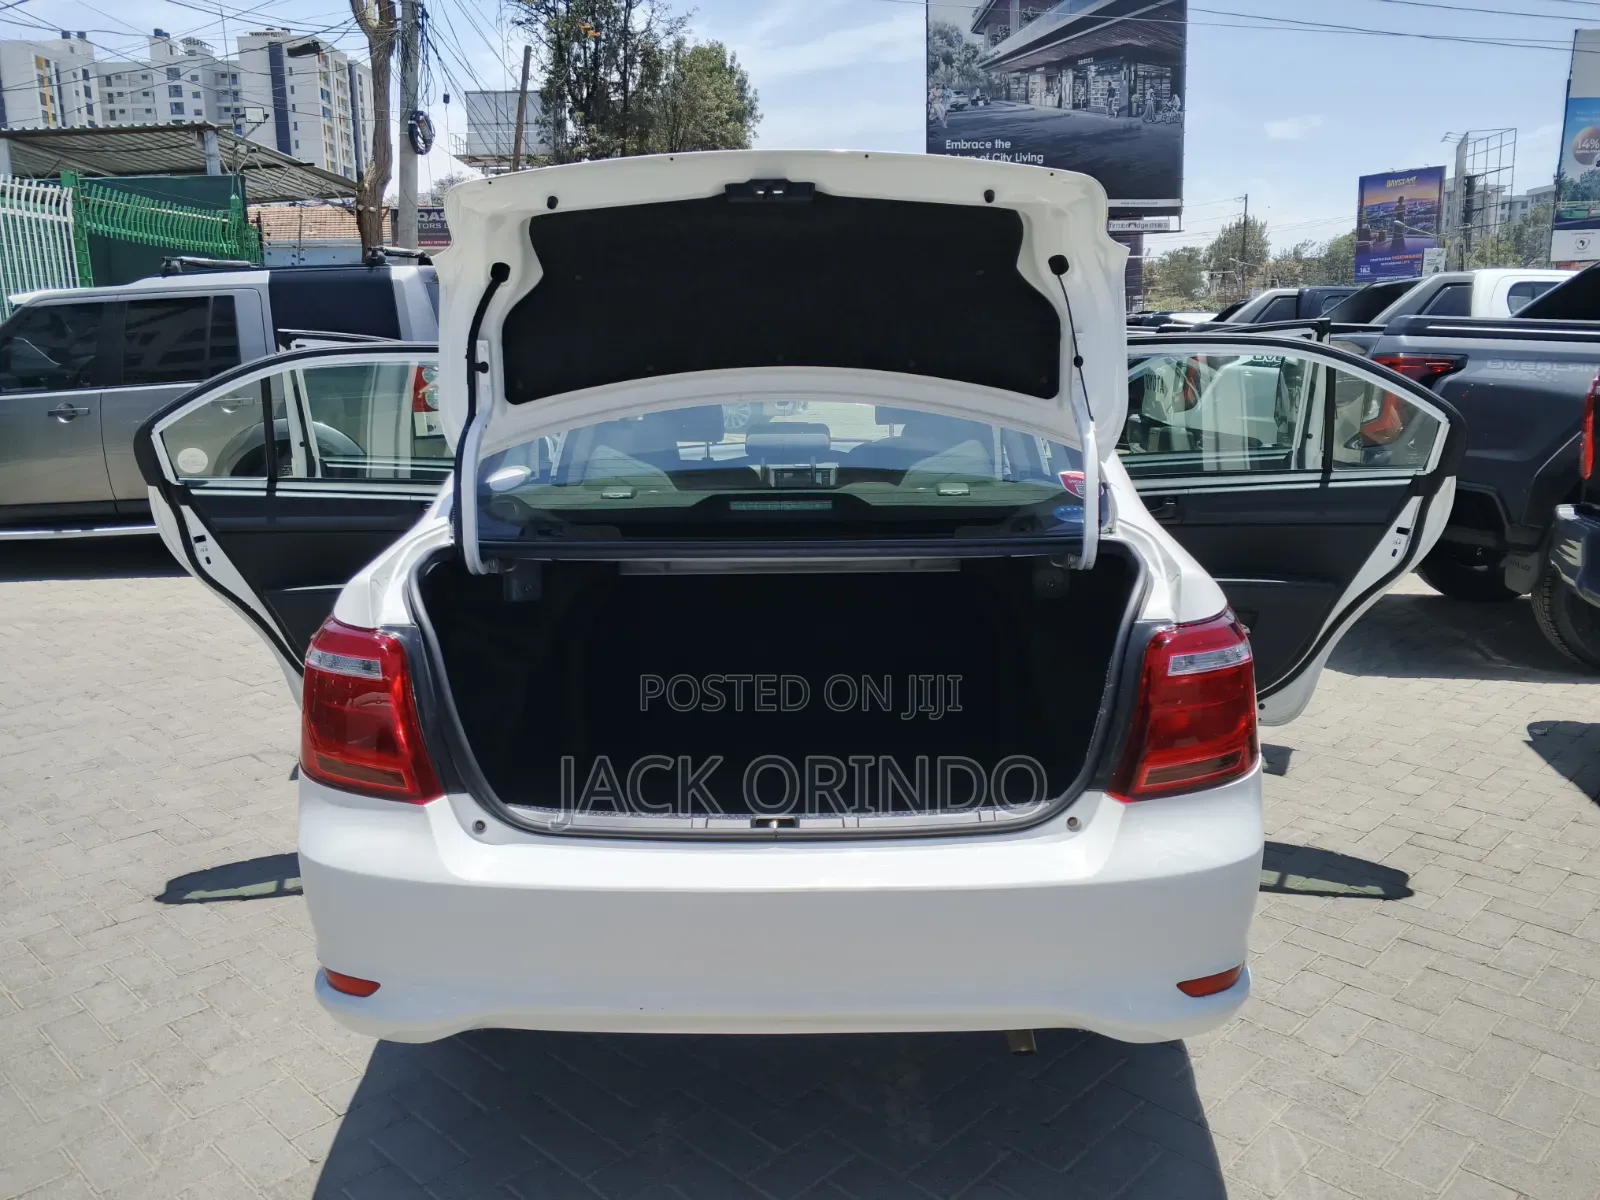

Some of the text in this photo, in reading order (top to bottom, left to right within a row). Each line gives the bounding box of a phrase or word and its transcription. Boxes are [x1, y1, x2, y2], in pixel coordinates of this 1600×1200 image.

[945, 138, 1011, 149] Embrace the
[1577, 138, 1600, 149] 14%
[992, 152, 1012, 163] City
[1015, 152, 1044, 164] Living
[1486, 359, 1600, 372] OVERLAN
